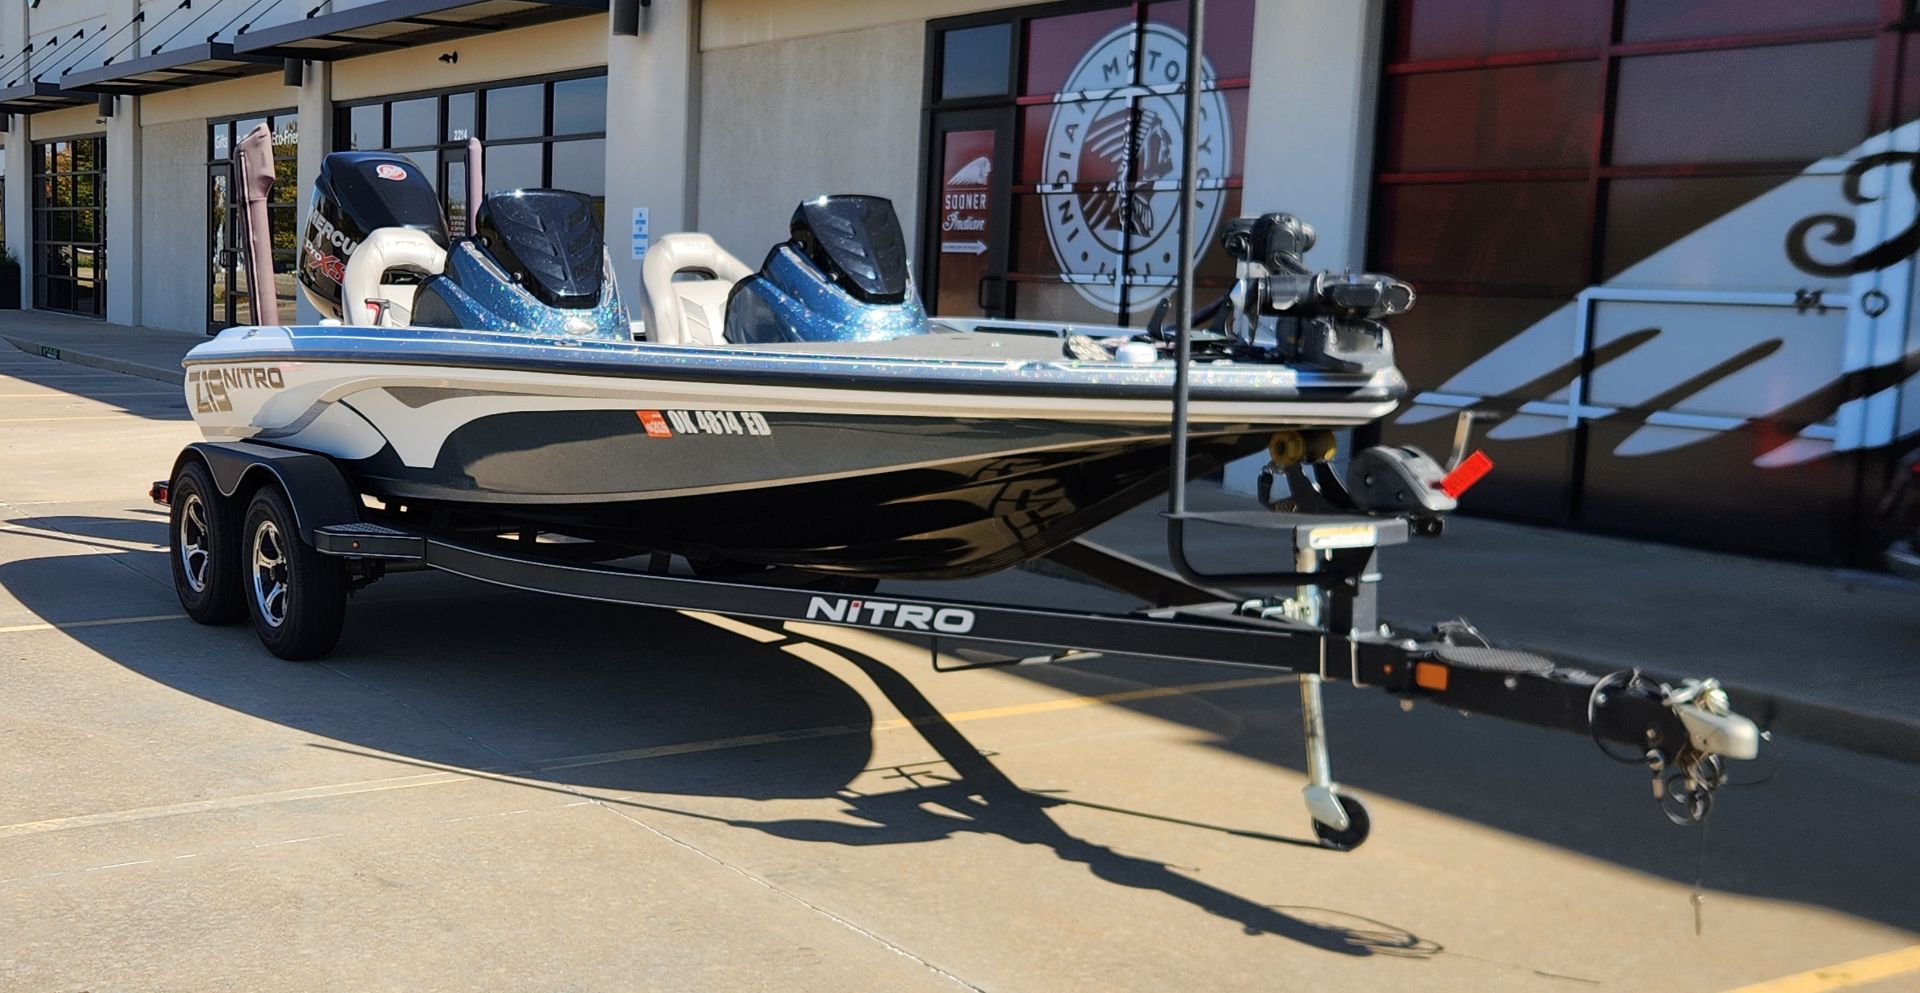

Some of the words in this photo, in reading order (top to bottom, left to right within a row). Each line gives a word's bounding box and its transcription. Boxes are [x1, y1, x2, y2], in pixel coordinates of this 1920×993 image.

[453, 128, 468, 141] 2214
[944, 193, 987, 210] SOONER
[942, 211, 986, 232] Indian
[304, 239, 323, 261] Pro
[222, 367, 285, 389] NITRO
[667, 410, 699, 434] OK
[695, 411, 743, 435] 4814
[740, 412, 772, 436] ED
[805, 596, 976, 634] NITRO
